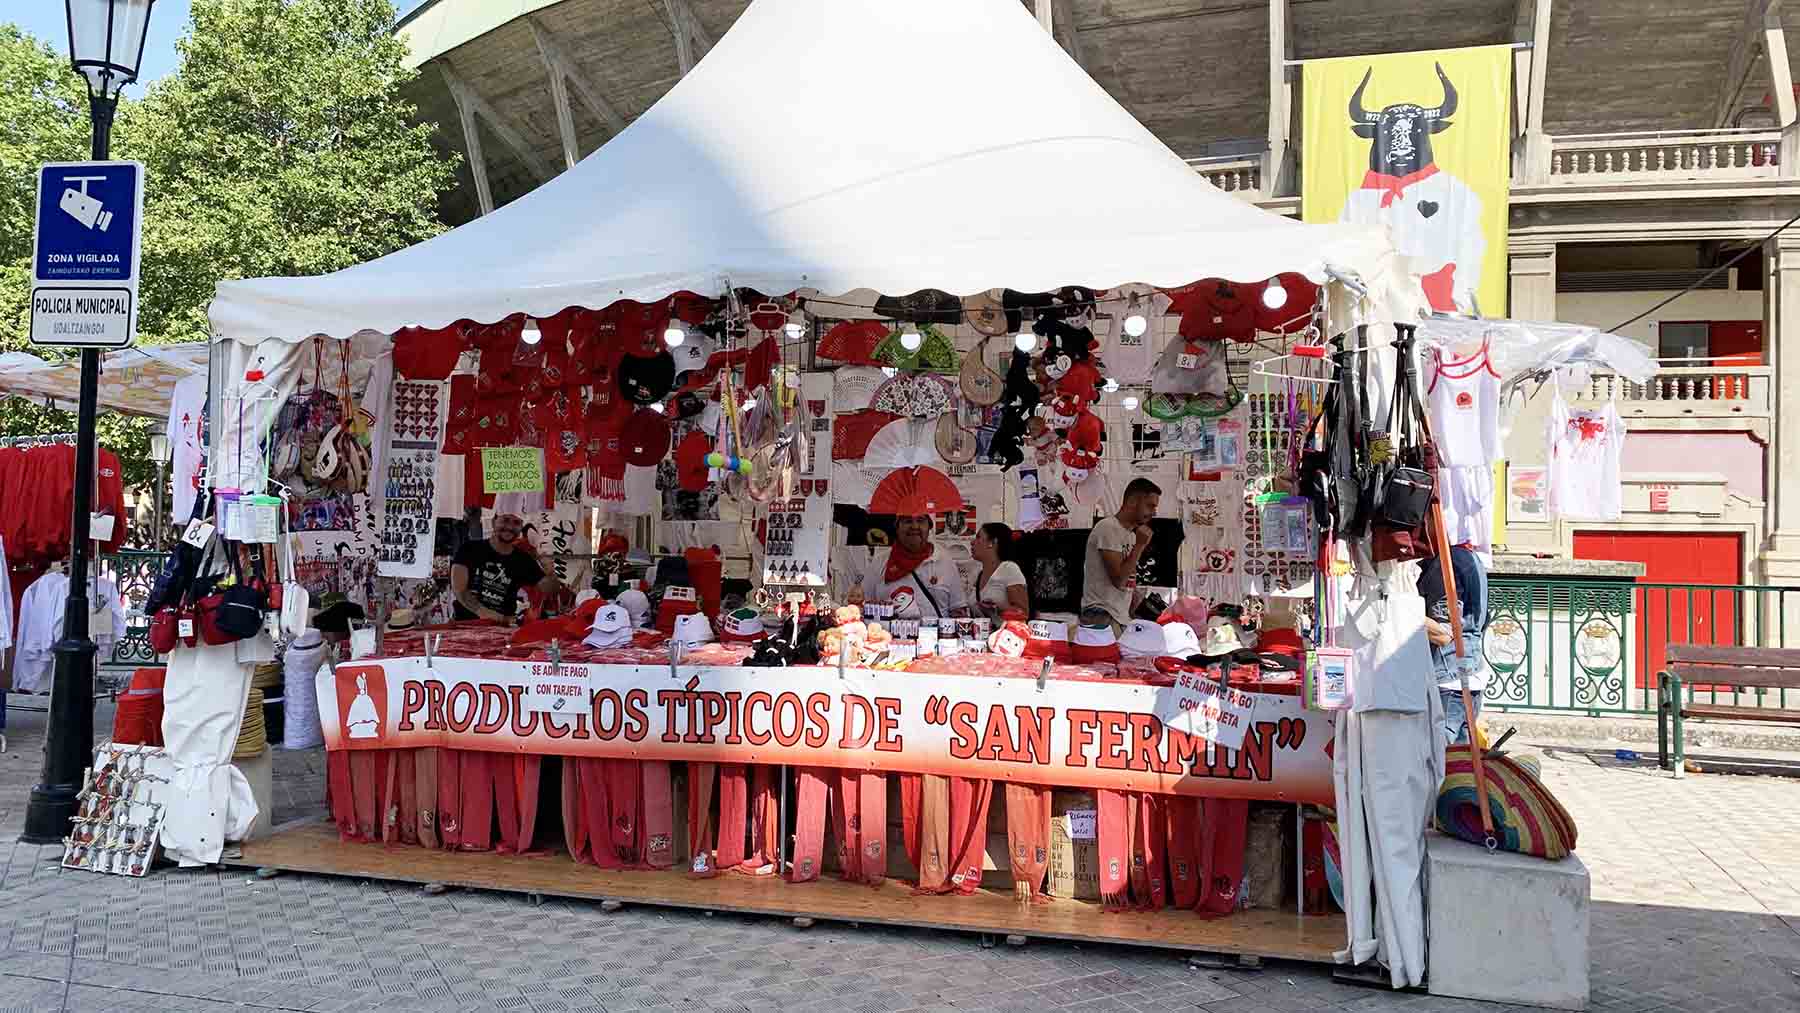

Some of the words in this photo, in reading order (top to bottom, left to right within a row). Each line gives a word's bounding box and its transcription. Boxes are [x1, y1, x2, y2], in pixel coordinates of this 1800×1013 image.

[47, 254, 74, 263] ZONA
[76, 254, 120, 263] VIGILADA
[35, 298, 72, 314] POLICIA
[75, 298, 127, 315] MUNICIPAL
[53, 322, 105, 335] UDALTZAINGOA
[488, 449, 532, 459] TENEMOS
[486, 470, 540, 480] BORDADOS
[492, 481, 510, 490] DEL
[1649, 491, 1668, 512] E
[531, 664, 542, 676] SE
[543, 665, 569, 677] ADTE
[569, 666, 589, 678] PAGO
[536, 684, 552, 695] CON
[553, 684, 583, 697] TARJETA
[1179, 674, 1193, 687] SE
[1192, 680, 1225, 699] ADMITE
[1227, 690, 1253, 709] PAGO
[657, 674, 831, 749] TÍPICOS
[839, 693, 903, 752] DE
[1179, 698, 1199, 712] CON
[1201, 704, 1239, 728] TARJETA
